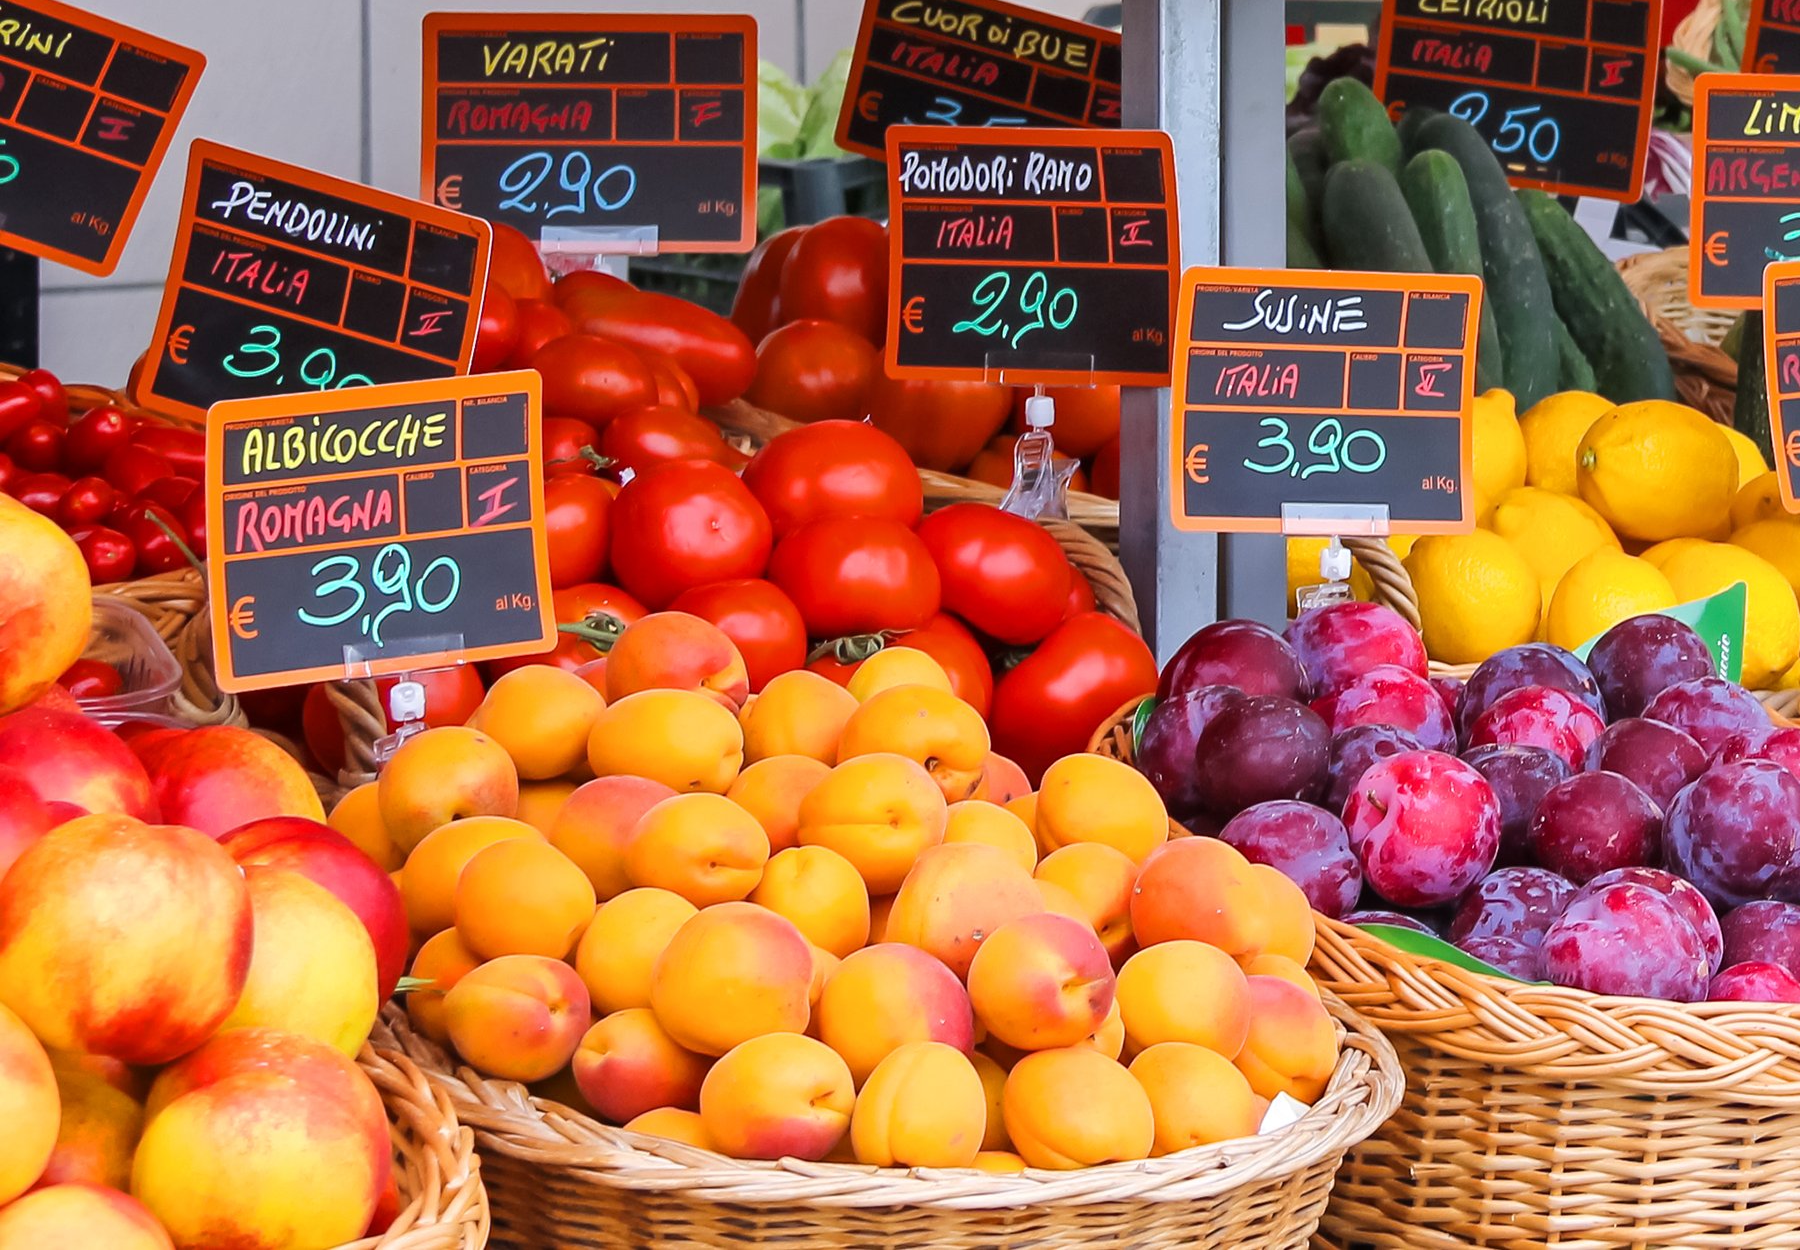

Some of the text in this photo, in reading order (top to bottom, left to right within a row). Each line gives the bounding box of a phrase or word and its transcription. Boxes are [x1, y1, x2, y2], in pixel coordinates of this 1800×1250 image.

[890, 0, 984, 43] CUOR
[1013, 30, 1089, 68] BUE
[447, 99, 593, 136] ROMAGNA
[857, 90, 883, 122] €
[437, 175, 463, 211] €
[697, 201, 711, 215] al
[1024, 150, 1093, 195] RAMO
[71, 209, 87, 225] al
[1704, 231, 1729, 266] €
[902, 296, 926, 334] €
[952, 271, 1078, 350] 2,90
[1131, 329, 1144, 342] al
[167, 324, 377, 392] € 3,9
[1185, 417, 1459, 494] € 3,90 al Kg.
[235, 489, 393, 553] ROMAGNA
[229, 543, 536, 648] € 3,90 al Kg.
